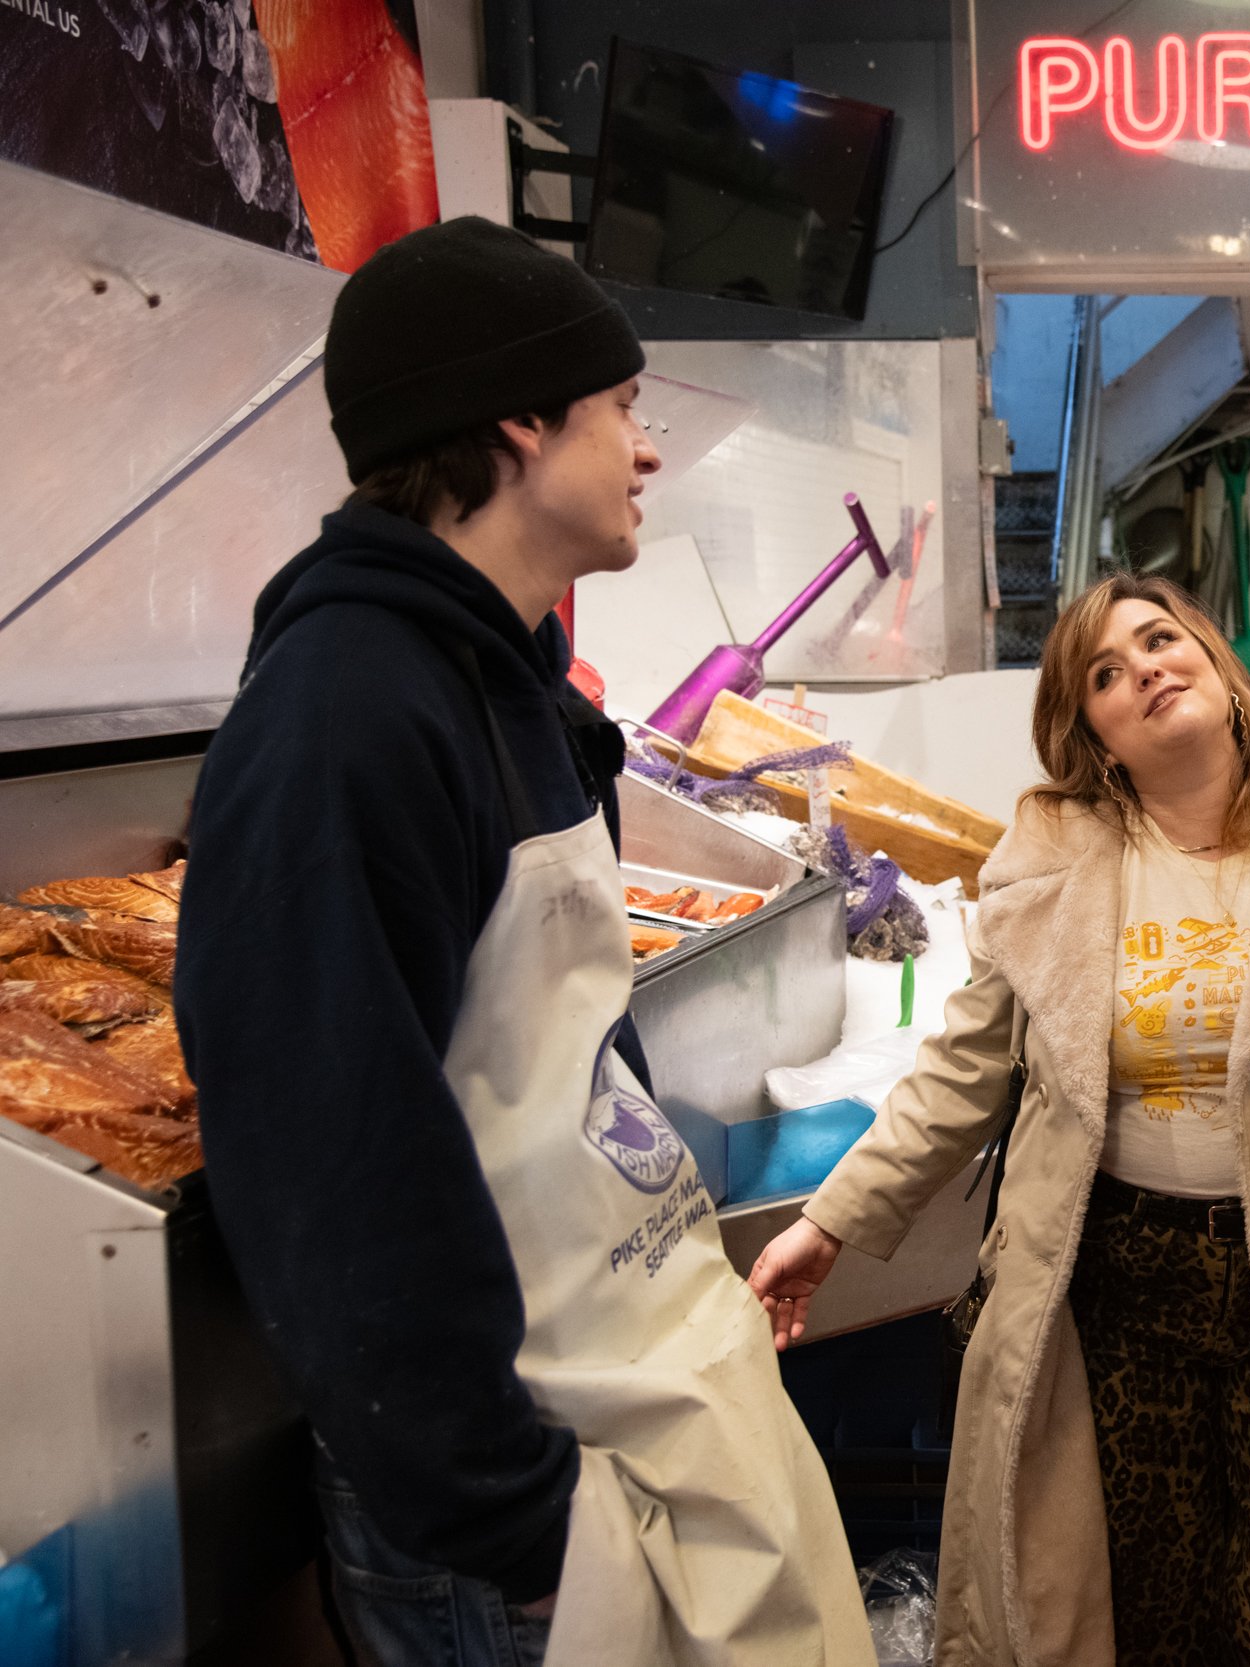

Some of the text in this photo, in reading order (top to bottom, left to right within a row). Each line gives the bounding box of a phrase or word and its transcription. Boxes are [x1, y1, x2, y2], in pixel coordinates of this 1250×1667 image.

[58, 8, 81, 38] US
[599, 1135, 651, 1180] FISH
[610, 1227, 646, 1274] PIKE
[645, 1195, 681, 1242] PLACE
[645, 1199, 712, 1279] SEATTLE WA.
